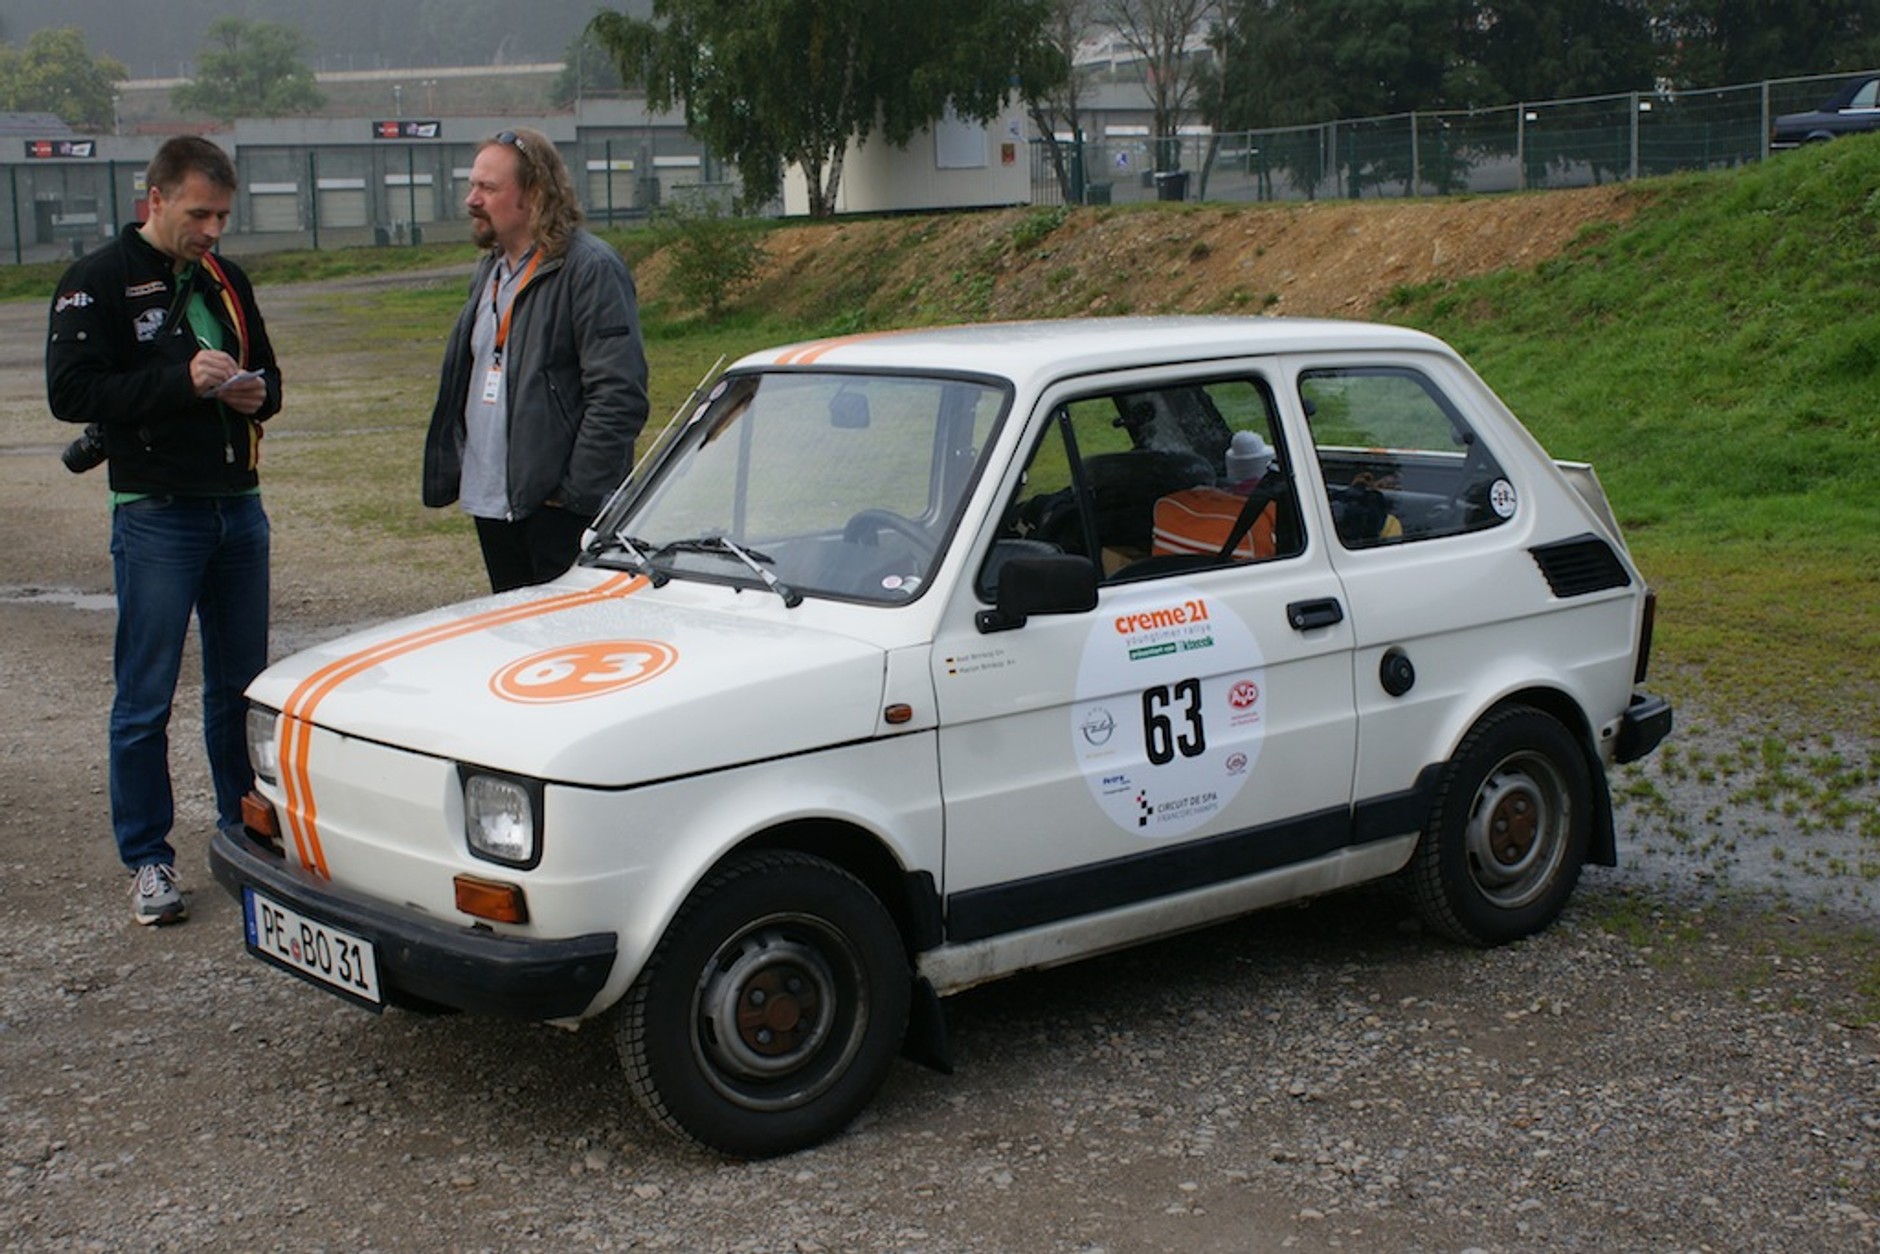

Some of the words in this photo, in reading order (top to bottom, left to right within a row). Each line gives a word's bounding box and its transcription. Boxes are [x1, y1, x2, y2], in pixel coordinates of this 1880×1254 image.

[513, 651, 654, 687] 63
[1142, 677, 1206, 767] 63
[1157, 797, 1190, 814] CIRCUIT
[1190, 795, 1201, 807] DE
[1203, 791, 1219, 804] SPA
[262, 903, 290, 956] PE
[300, 922, 333, 975] BO
[334, 937, 370, 991] 31
